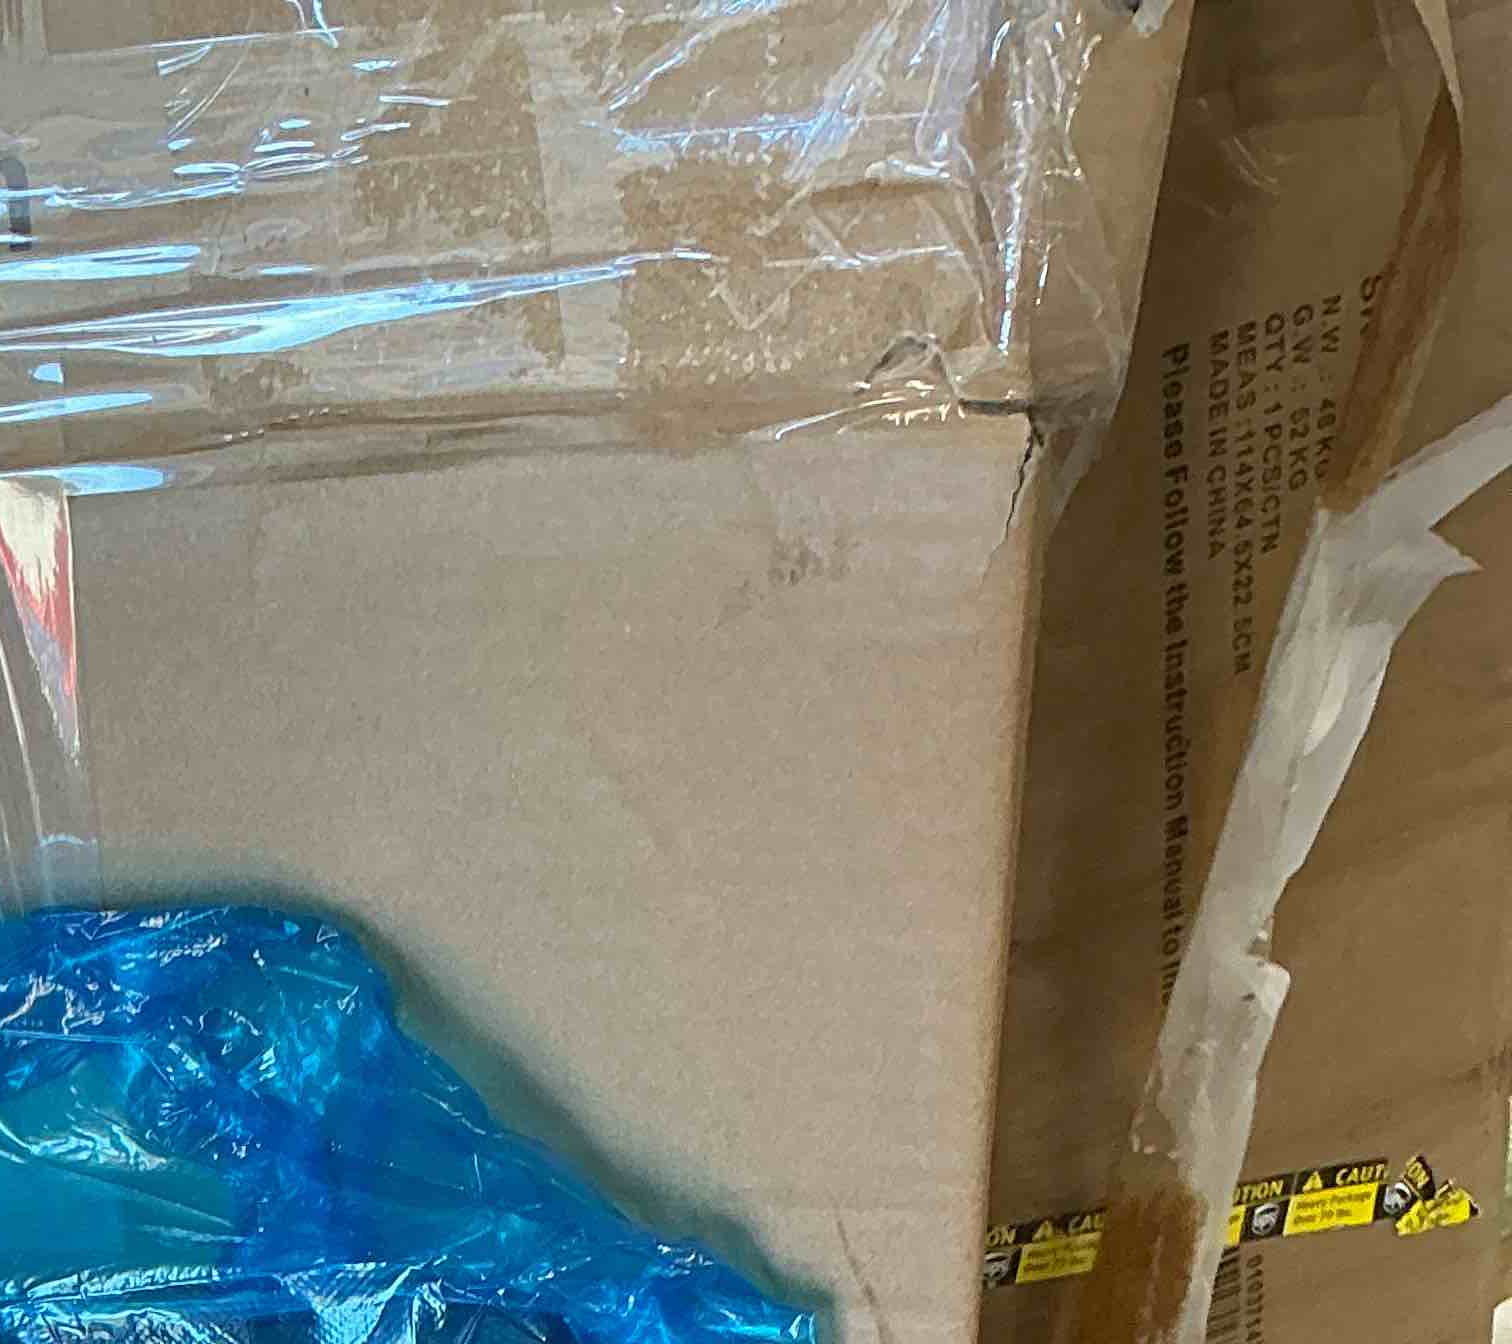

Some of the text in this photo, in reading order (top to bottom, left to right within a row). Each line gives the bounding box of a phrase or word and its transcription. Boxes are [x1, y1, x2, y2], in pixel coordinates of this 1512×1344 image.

[1265, 313, 1286, 373] QTY
[1162, 341, 1191, 459] Please
[1206, 330, 1230, 558] MADE IN CHINA
[1289, 447, 1309, 491] KG
[1164, 464, 1190, 576] Follow
[1165, 583, 1191, 635] the
[1165, 640, 1191, 811] Instruction
[1163, 816, 1191, 917] Manual
[1162, 925, 1185, 955] to
